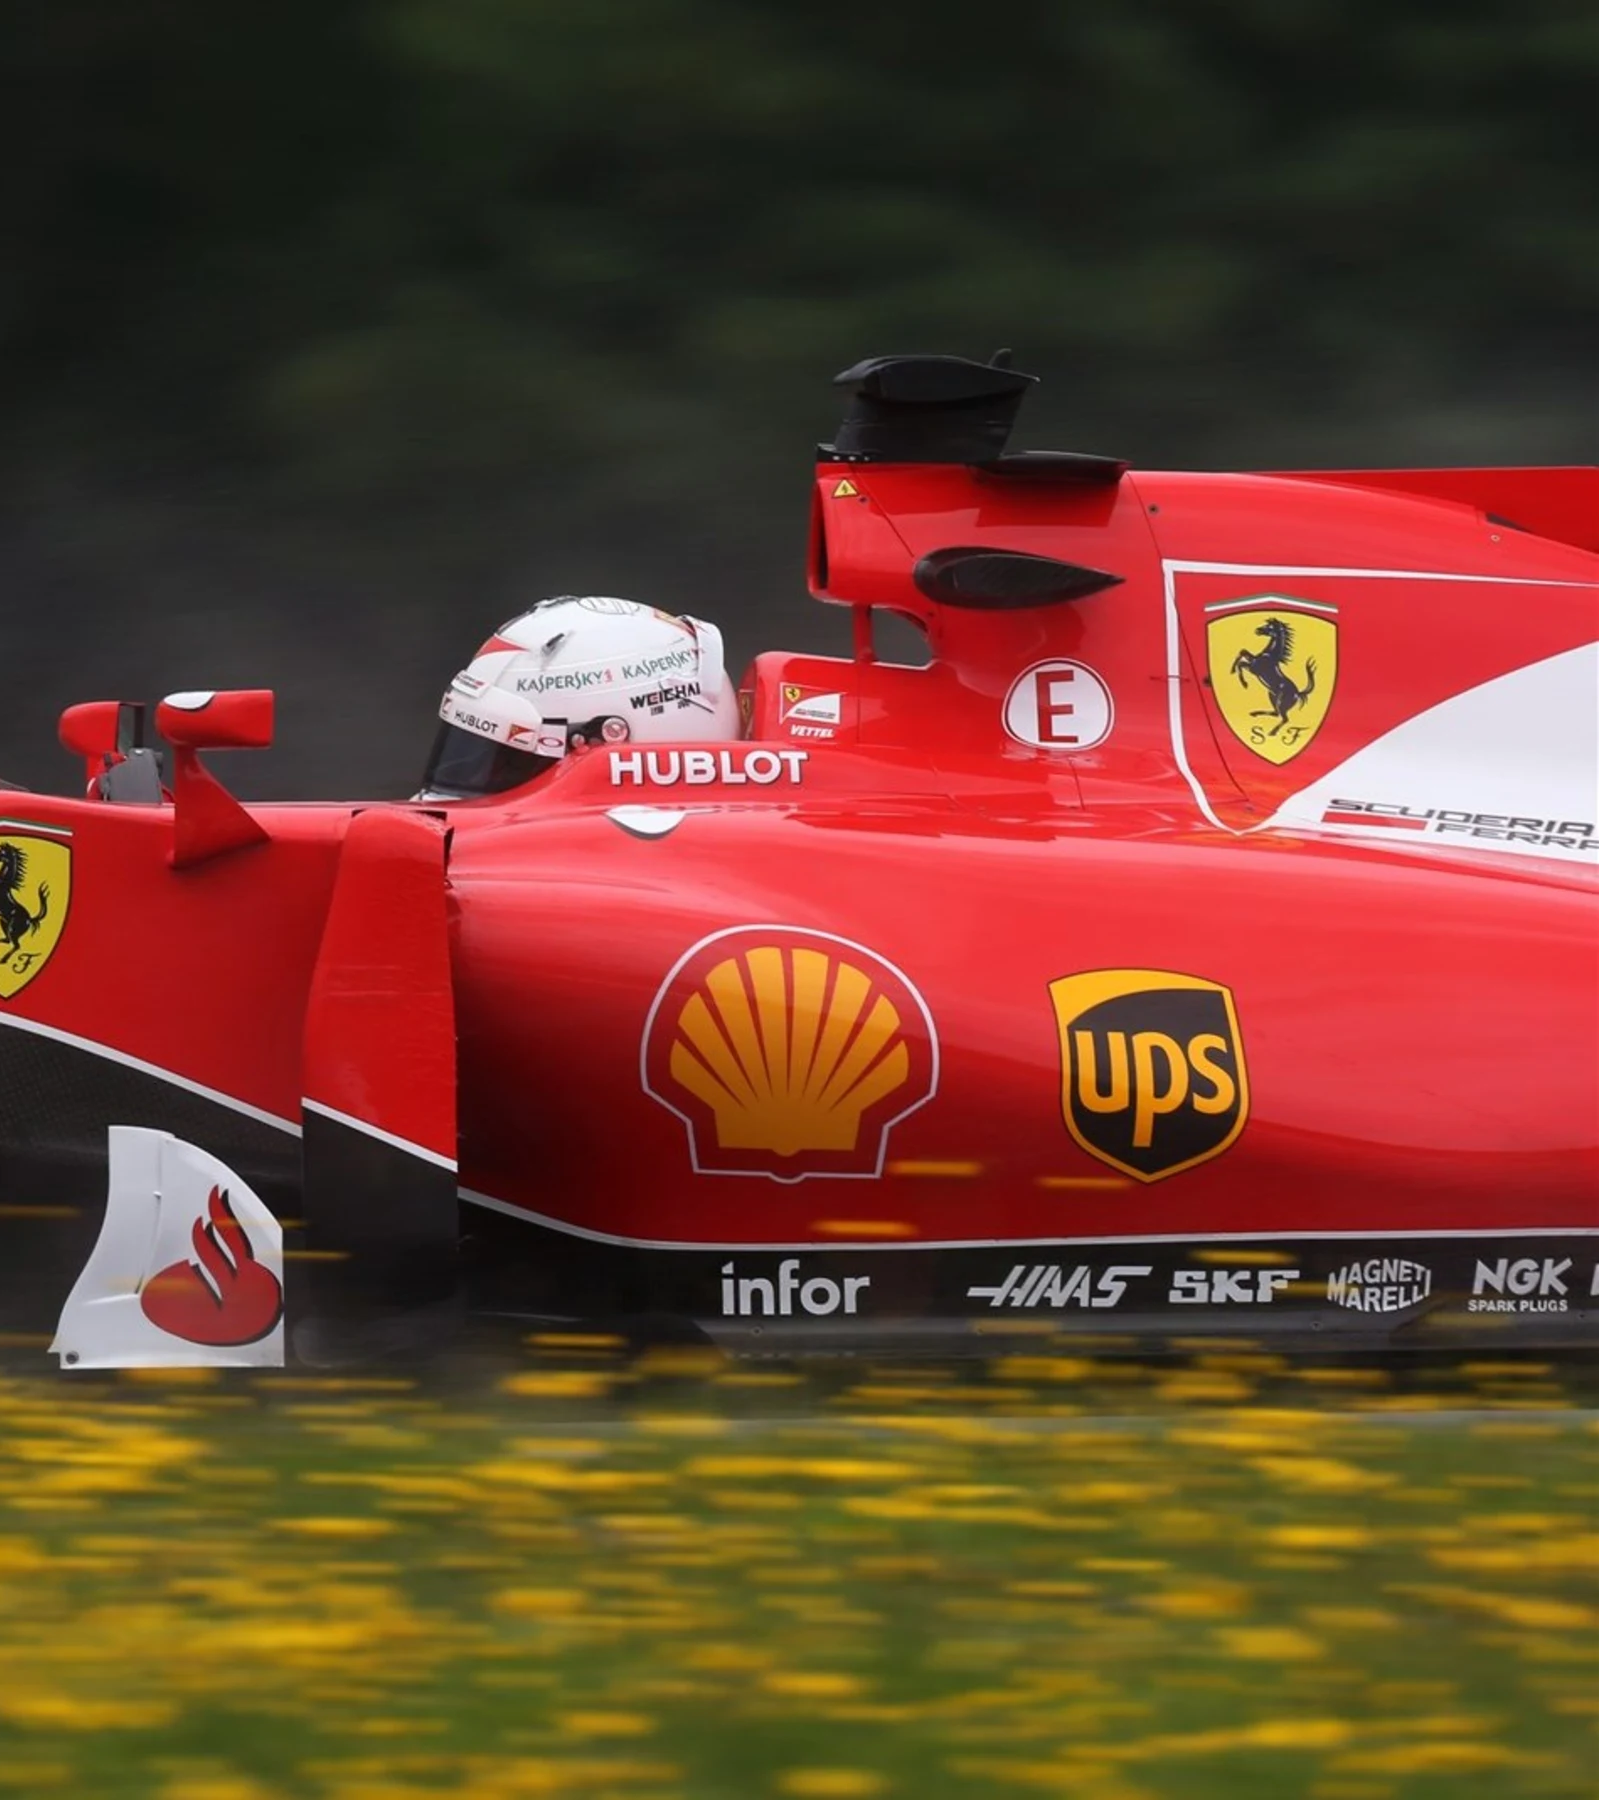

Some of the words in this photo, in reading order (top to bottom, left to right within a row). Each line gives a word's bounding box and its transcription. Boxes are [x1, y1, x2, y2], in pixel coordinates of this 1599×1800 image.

[516, 671, 603, 693] KASPERSKY
[454, 709, 499, 735] HUBLOT
[1035, 669, 1079, 744] E
[790, 724, 835, 738] VETTEL
[609, 750, 808, 786] HUBLOT
[1327, 798, 1595, 837] SCUDERIA
[721, 1259, 870, 1315] infor
[966, 1264, 1153, 1308] HAAS
[1168, 1269, 1300, 1304] SKF
[1327, 1258, 1431, 1290] MAGNETI
[1472, 1257, 1573, 1296] NGK
[1327, 1279, 1431, 1313] MARELLI
[1468, 1299, 1517, 1313] SPARK
[1519, 1299, 1568, 1313] PLUGS
